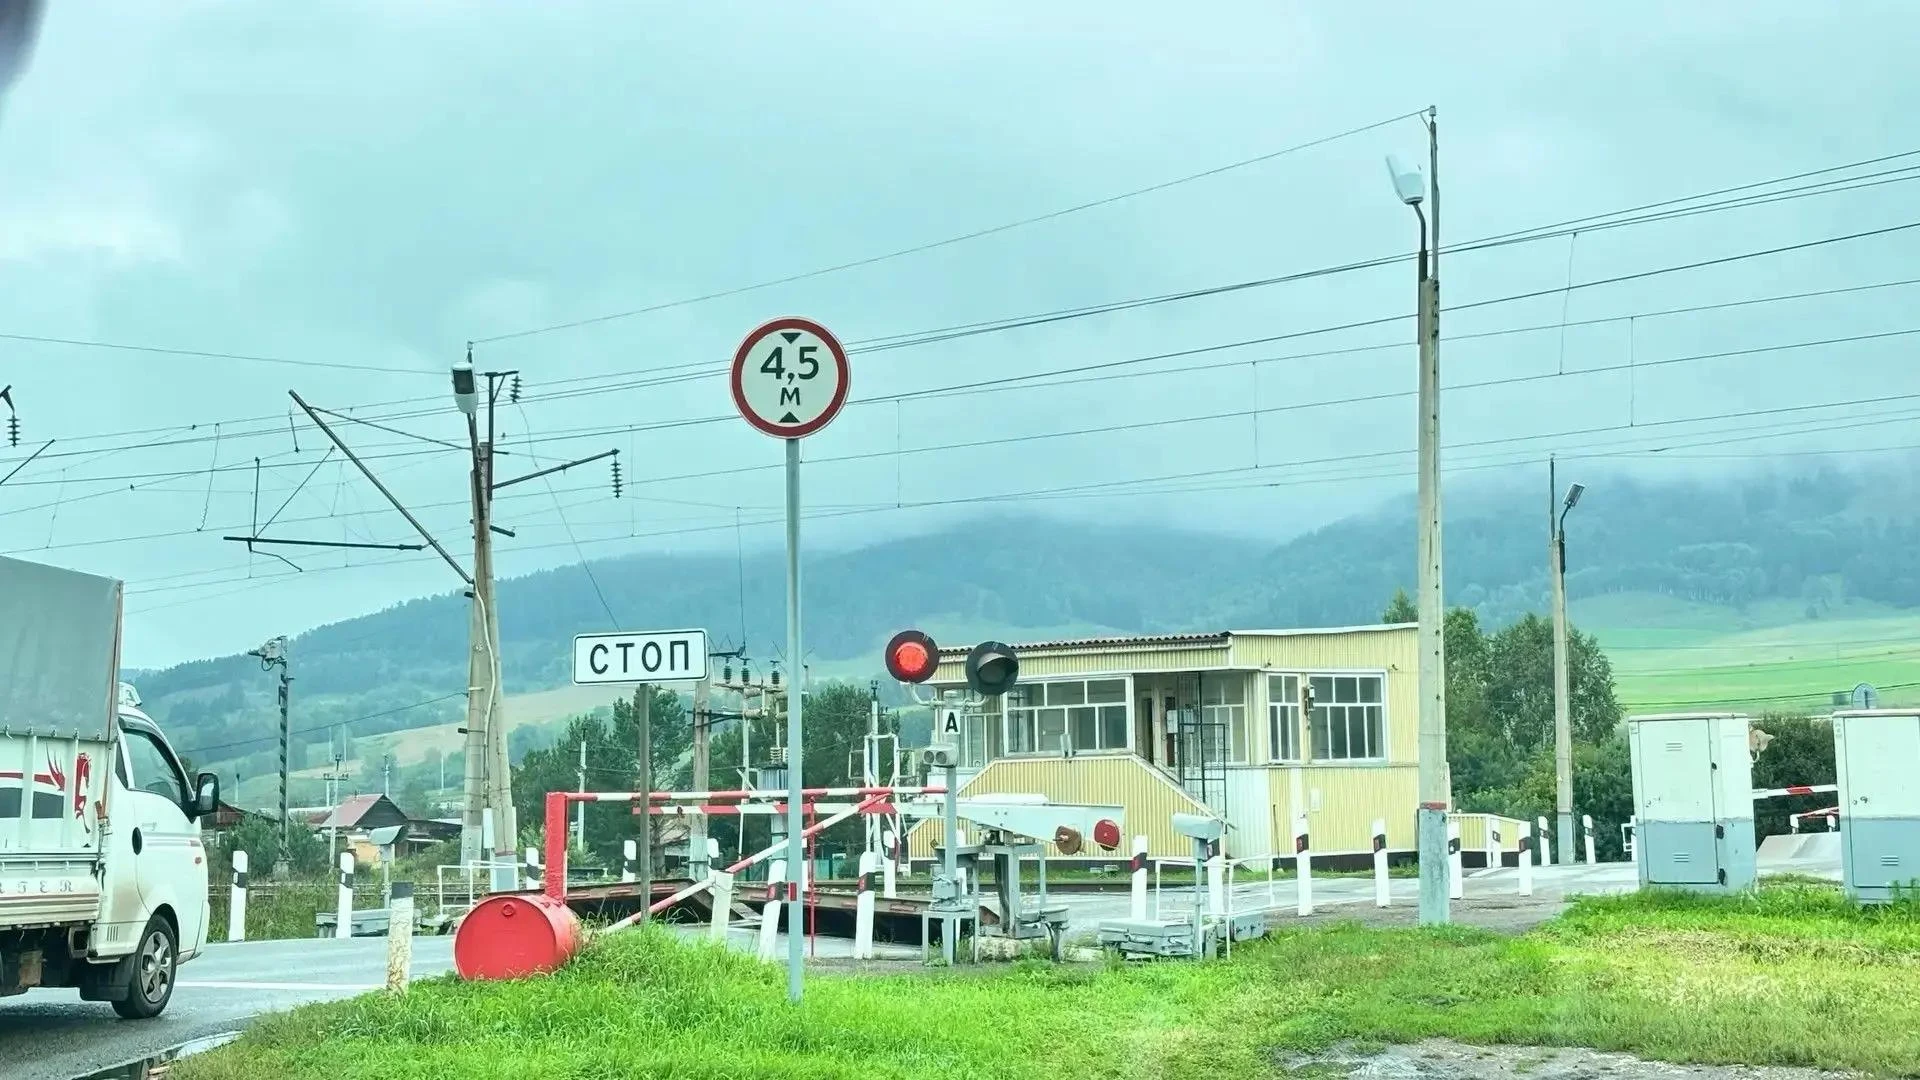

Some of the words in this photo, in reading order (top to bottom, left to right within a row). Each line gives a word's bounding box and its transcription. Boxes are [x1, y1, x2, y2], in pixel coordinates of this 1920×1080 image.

[760, 346, 819, 385] 4,5
[589, 640, 690, 674] СТОП
[945, 711, 959, 733] А
